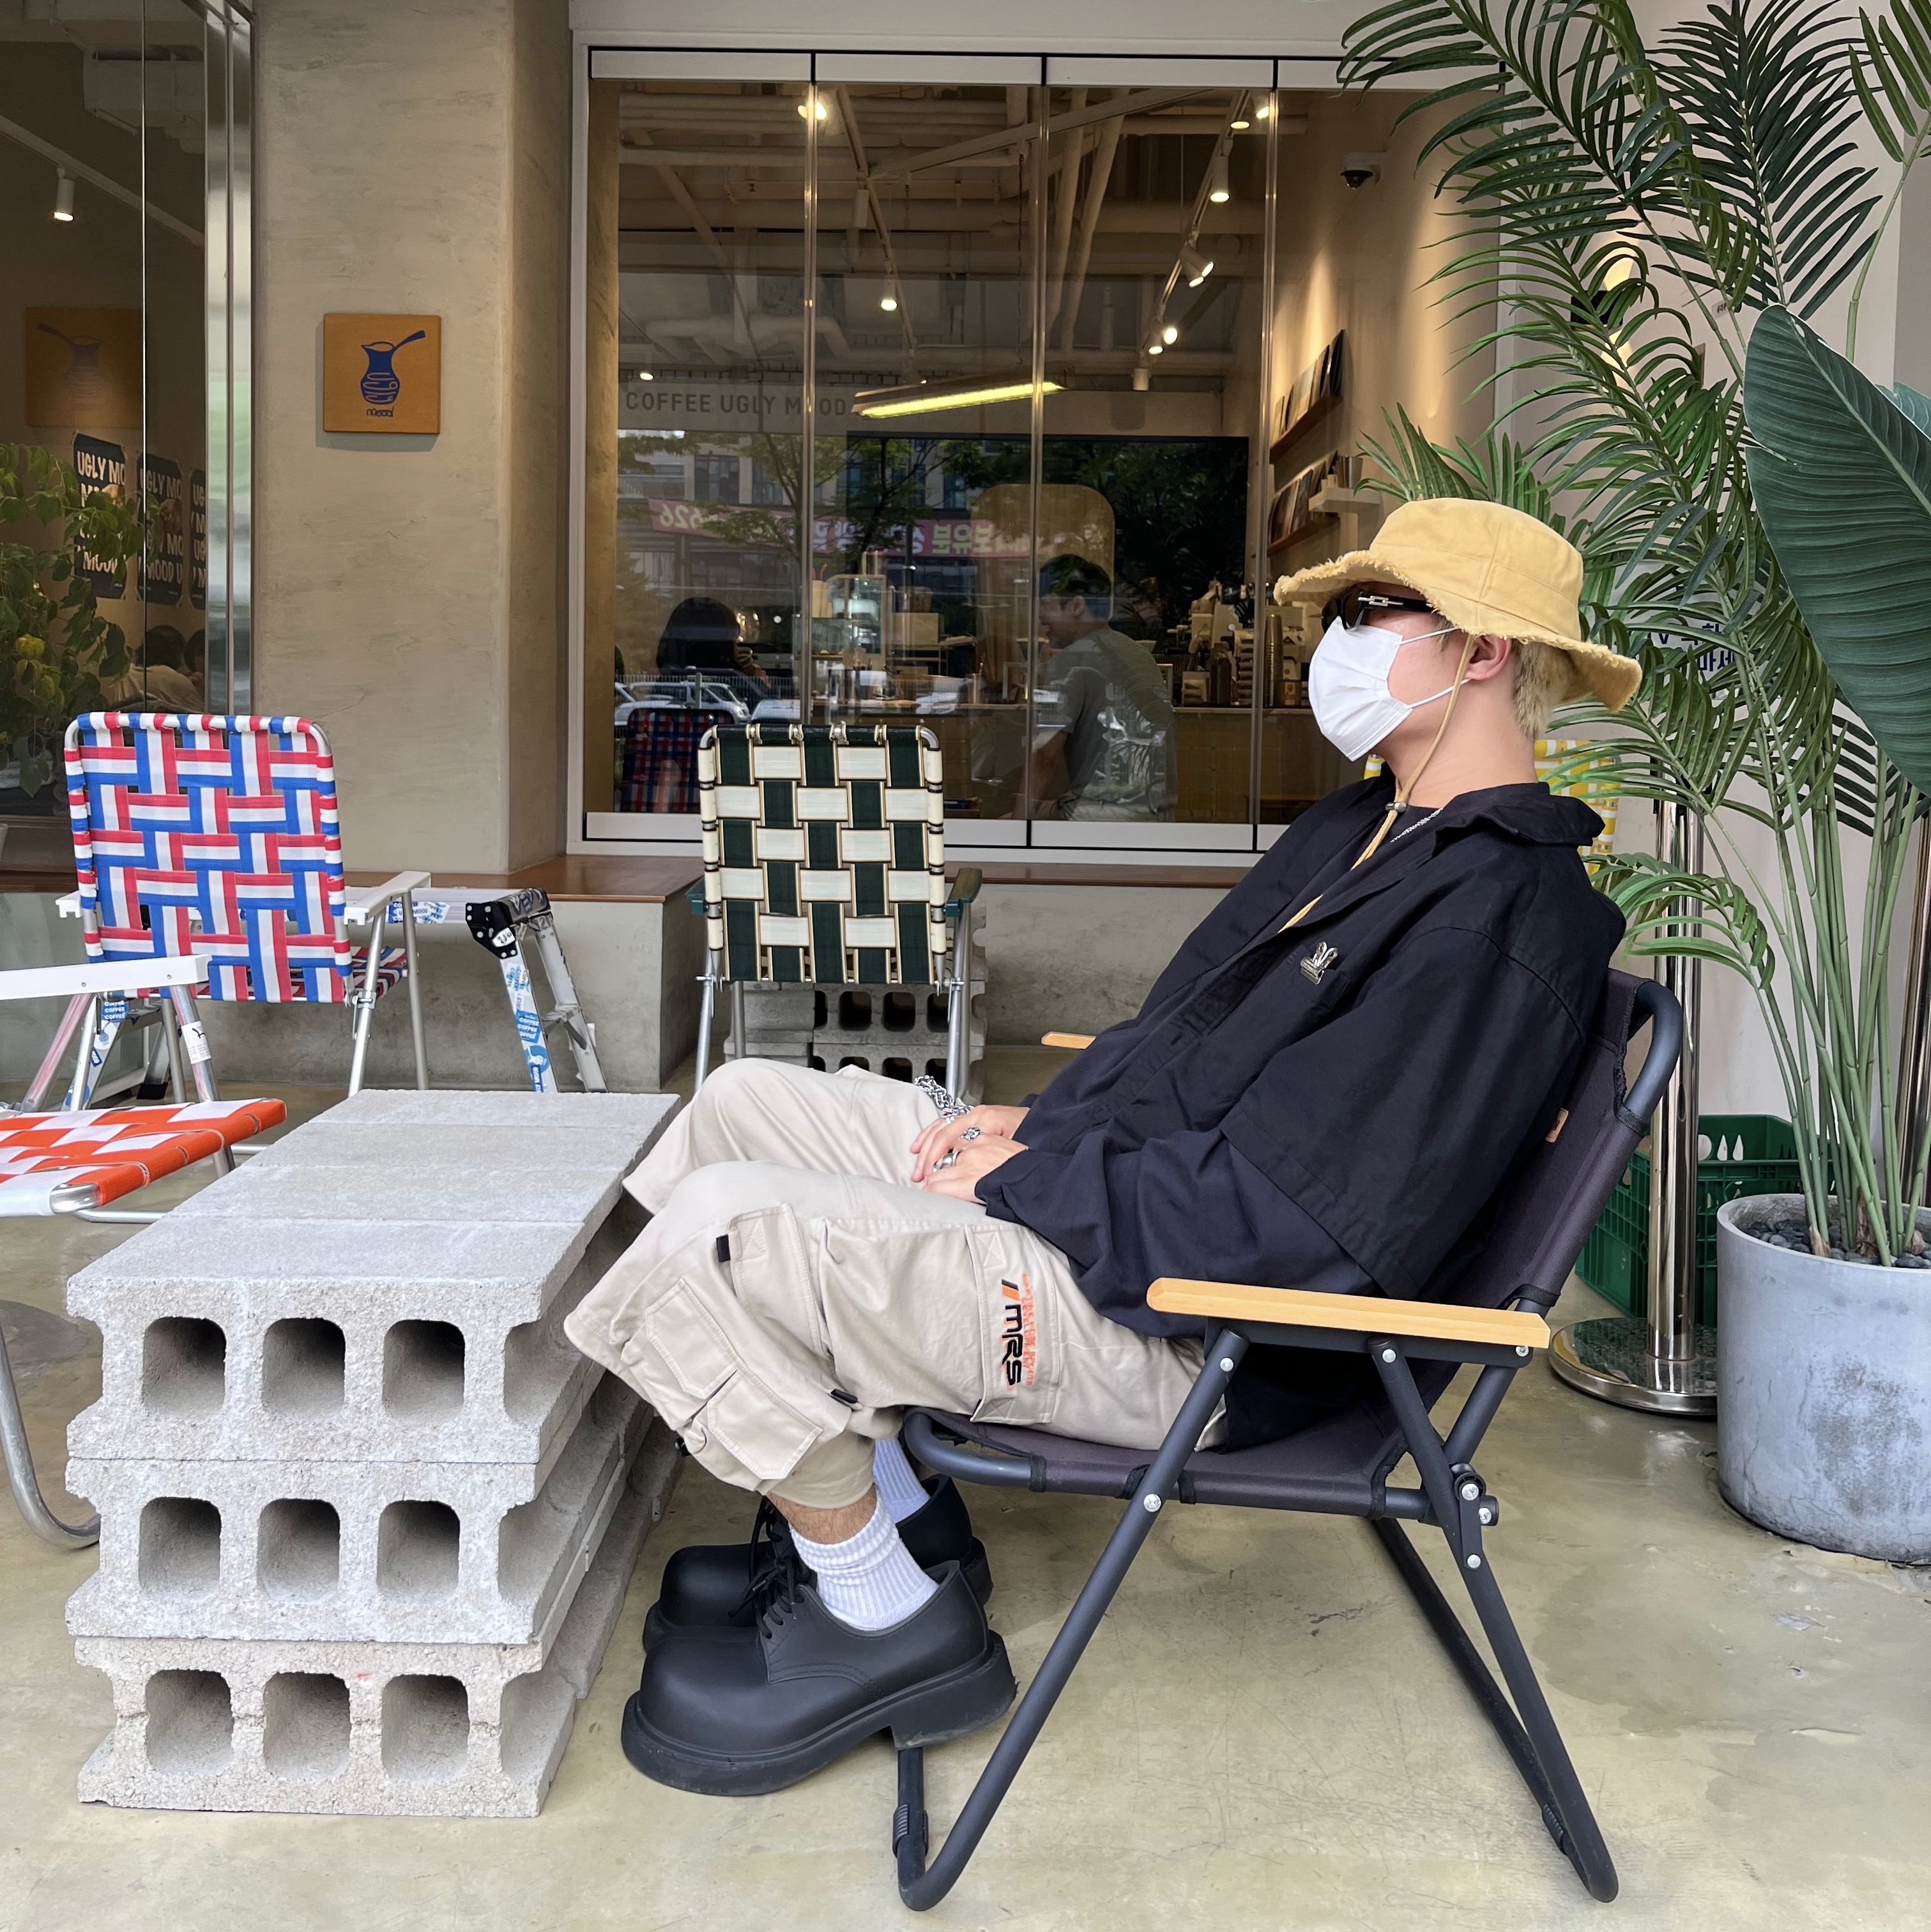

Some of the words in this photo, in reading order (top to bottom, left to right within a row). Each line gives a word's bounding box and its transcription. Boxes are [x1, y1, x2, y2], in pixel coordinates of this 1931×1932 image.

[625, 391, 712, 413] COFFEE
[720, 394, 775, 414] UGLY
[785, 396, 847, 415] MOD
[77, 450, 106, 480] UGLY
